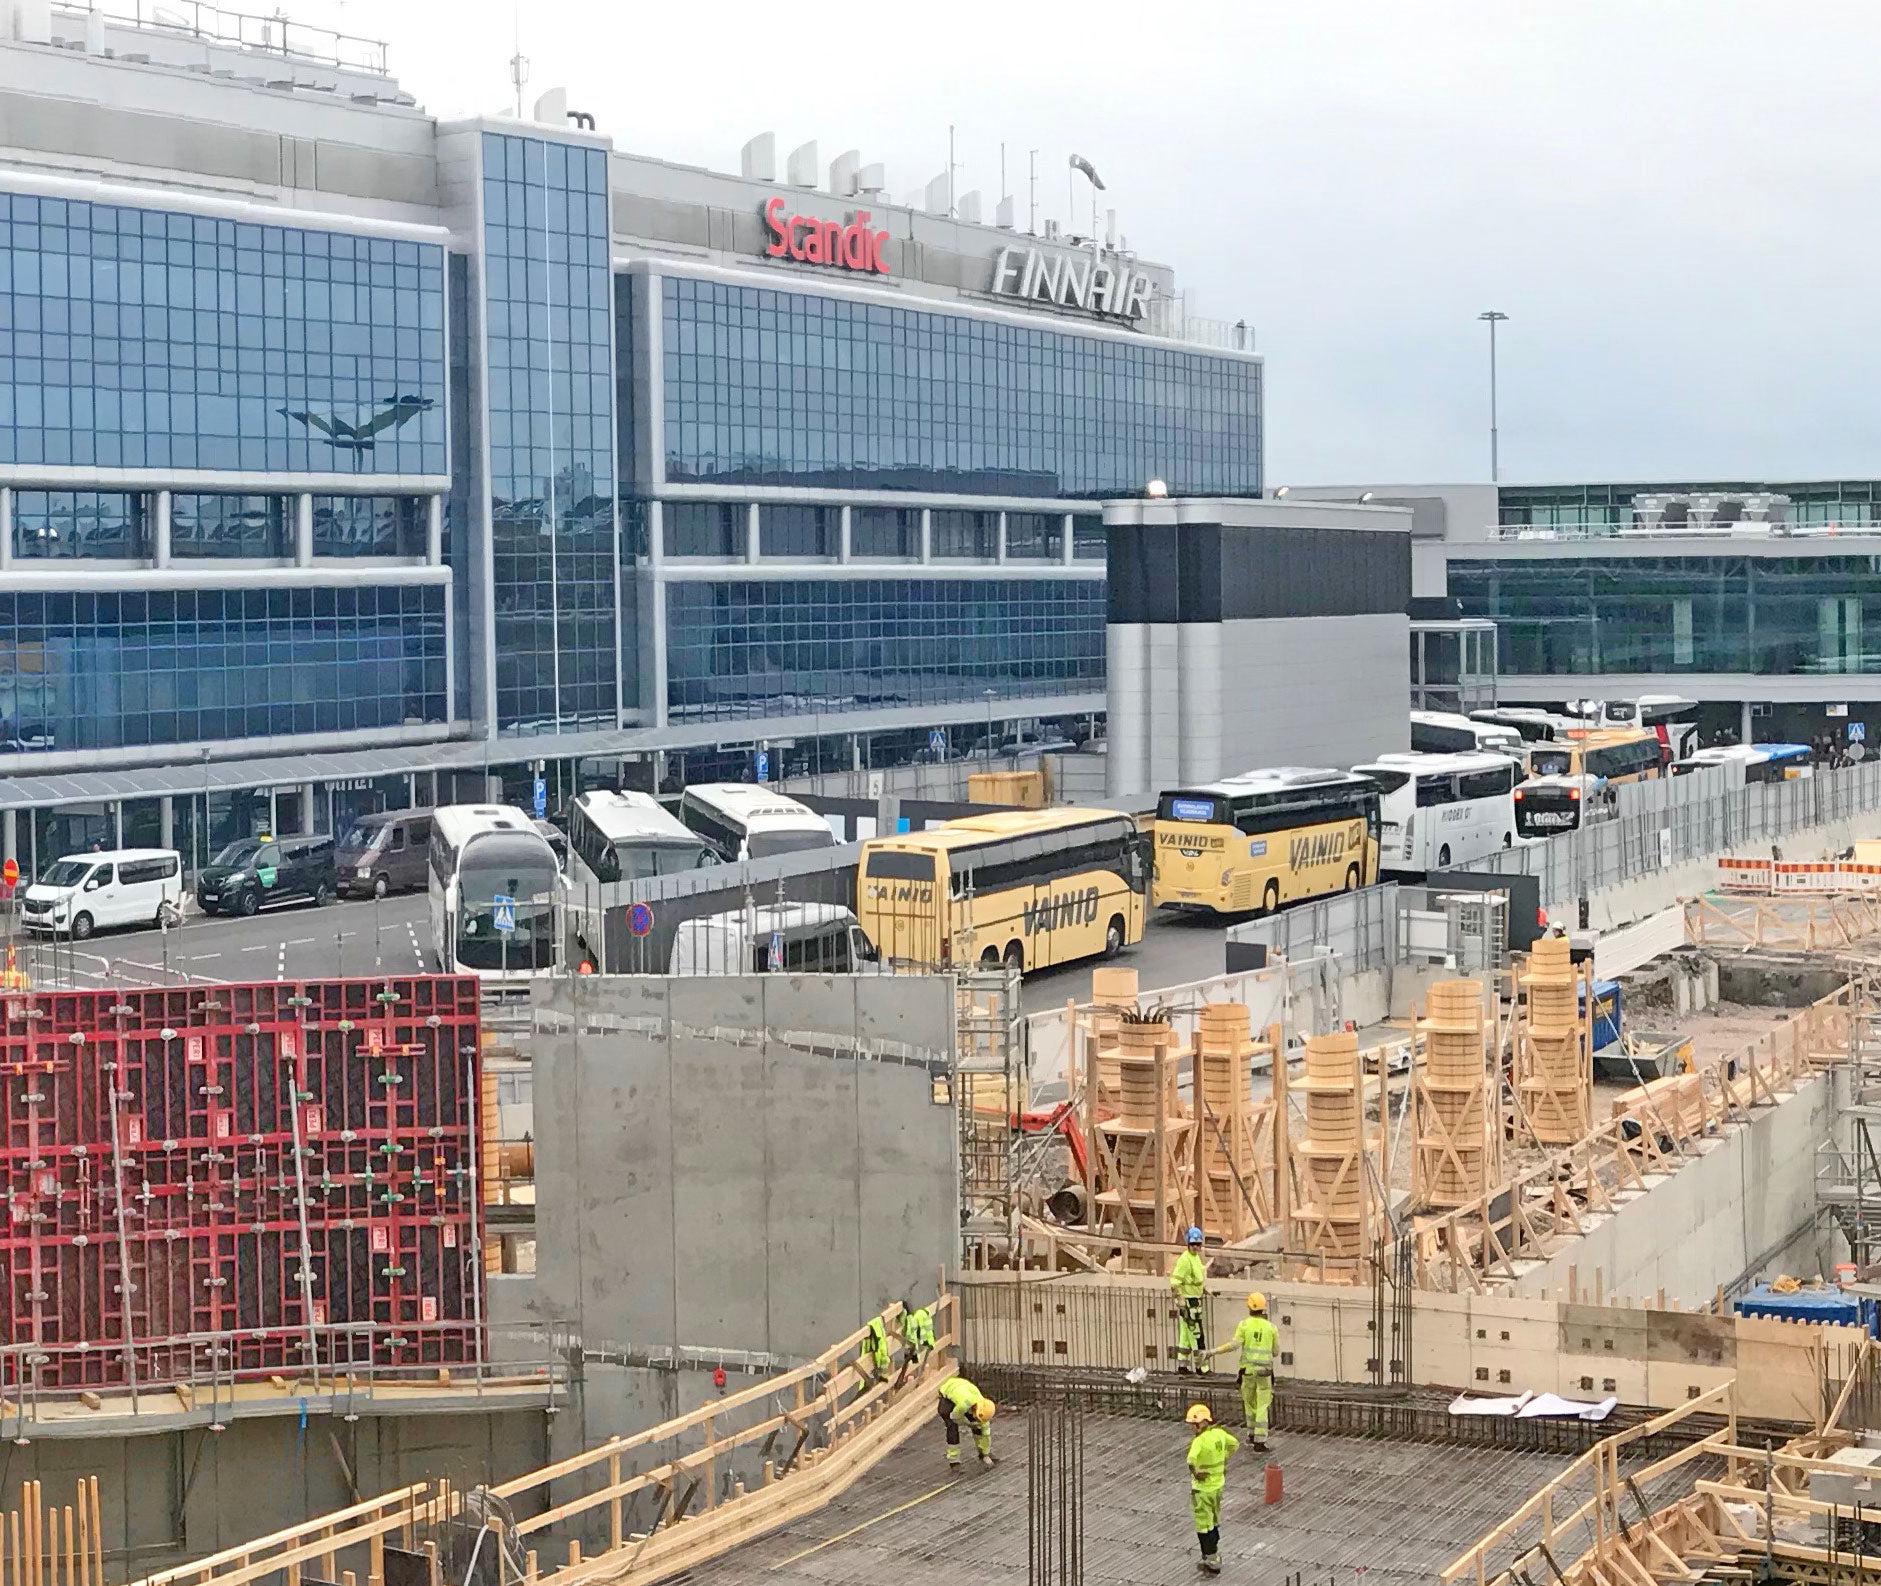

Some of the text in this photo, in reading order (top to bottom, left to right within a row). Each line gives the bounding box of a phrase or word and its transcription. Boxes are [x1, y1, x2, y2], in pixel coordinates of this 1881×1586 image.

[766, 197, 891, 275] Scandic
[992, 244, 1153, 320] FINNAIR
[536, 781, 545, 800] P
[1160, 833, 1208, 847] VAINIO
[1290, 831, 1345, 871] VAINIO
[1024, 886, 1099, 937] VAINIO
